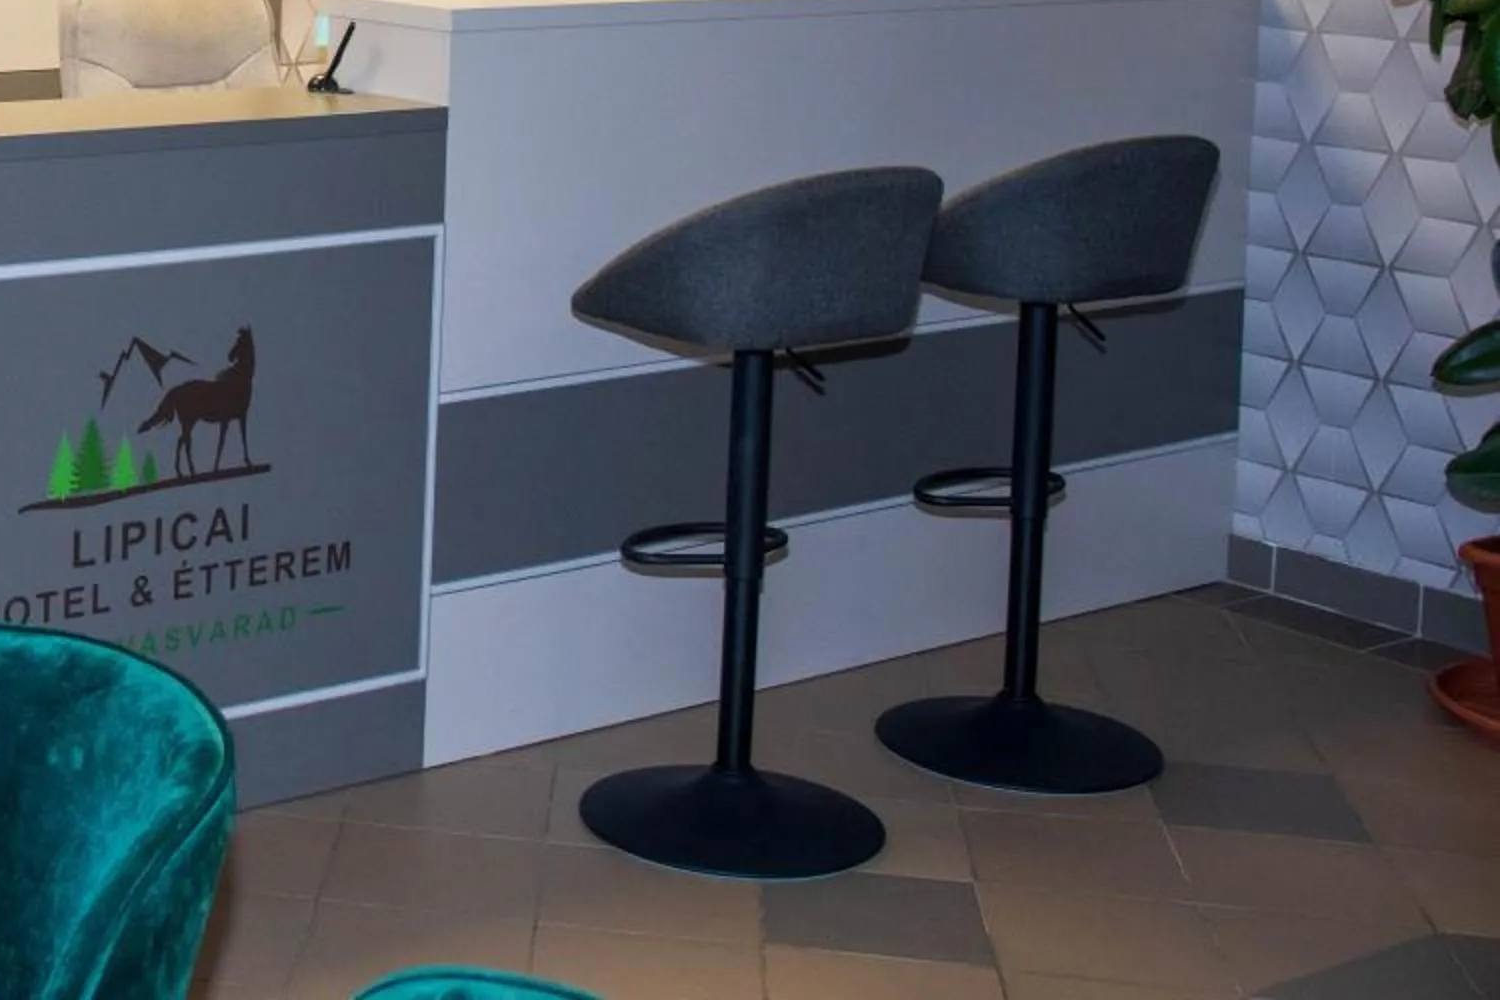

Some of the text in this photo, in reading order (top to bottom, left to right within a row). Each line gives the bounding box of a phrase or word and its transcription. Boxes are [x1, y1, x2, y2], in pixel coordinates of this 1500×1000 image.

[72, 503, 250, 568] LIPICAI
[130, 575, 153, 607] &
[173, 541, 351, 600] ÉTTEREM
